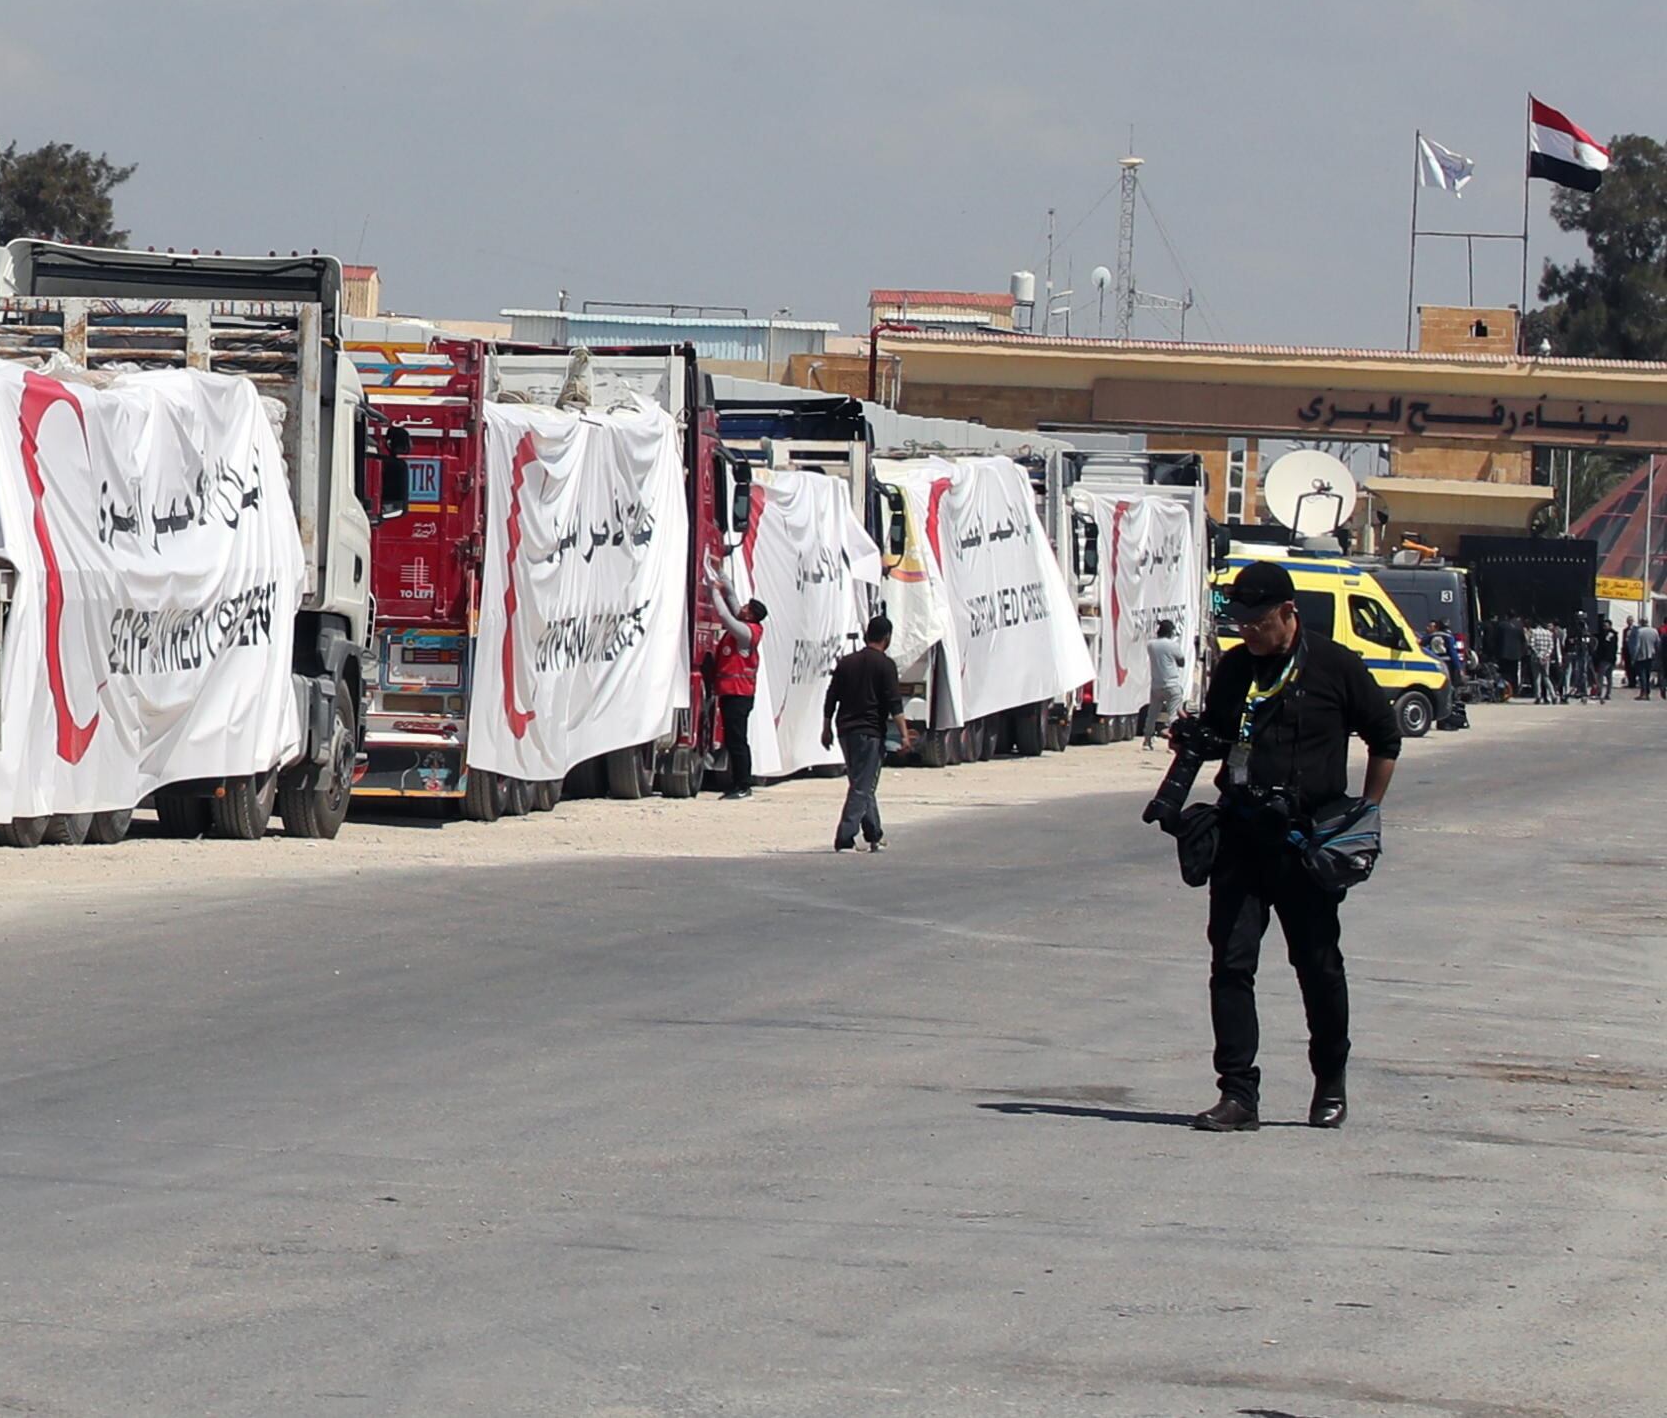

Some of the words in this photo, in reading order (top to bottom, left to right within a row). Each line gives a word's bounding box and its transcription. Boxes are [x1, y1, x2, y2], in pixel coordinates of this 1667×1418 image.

[1407, 397, 1518, 434] رفح
[409, 463, 436, 492] TIR
[399, 589, 413, 598] TO
[414, 589, 435, 599] LEFT
[1442, 591, 1451, 602] 3
